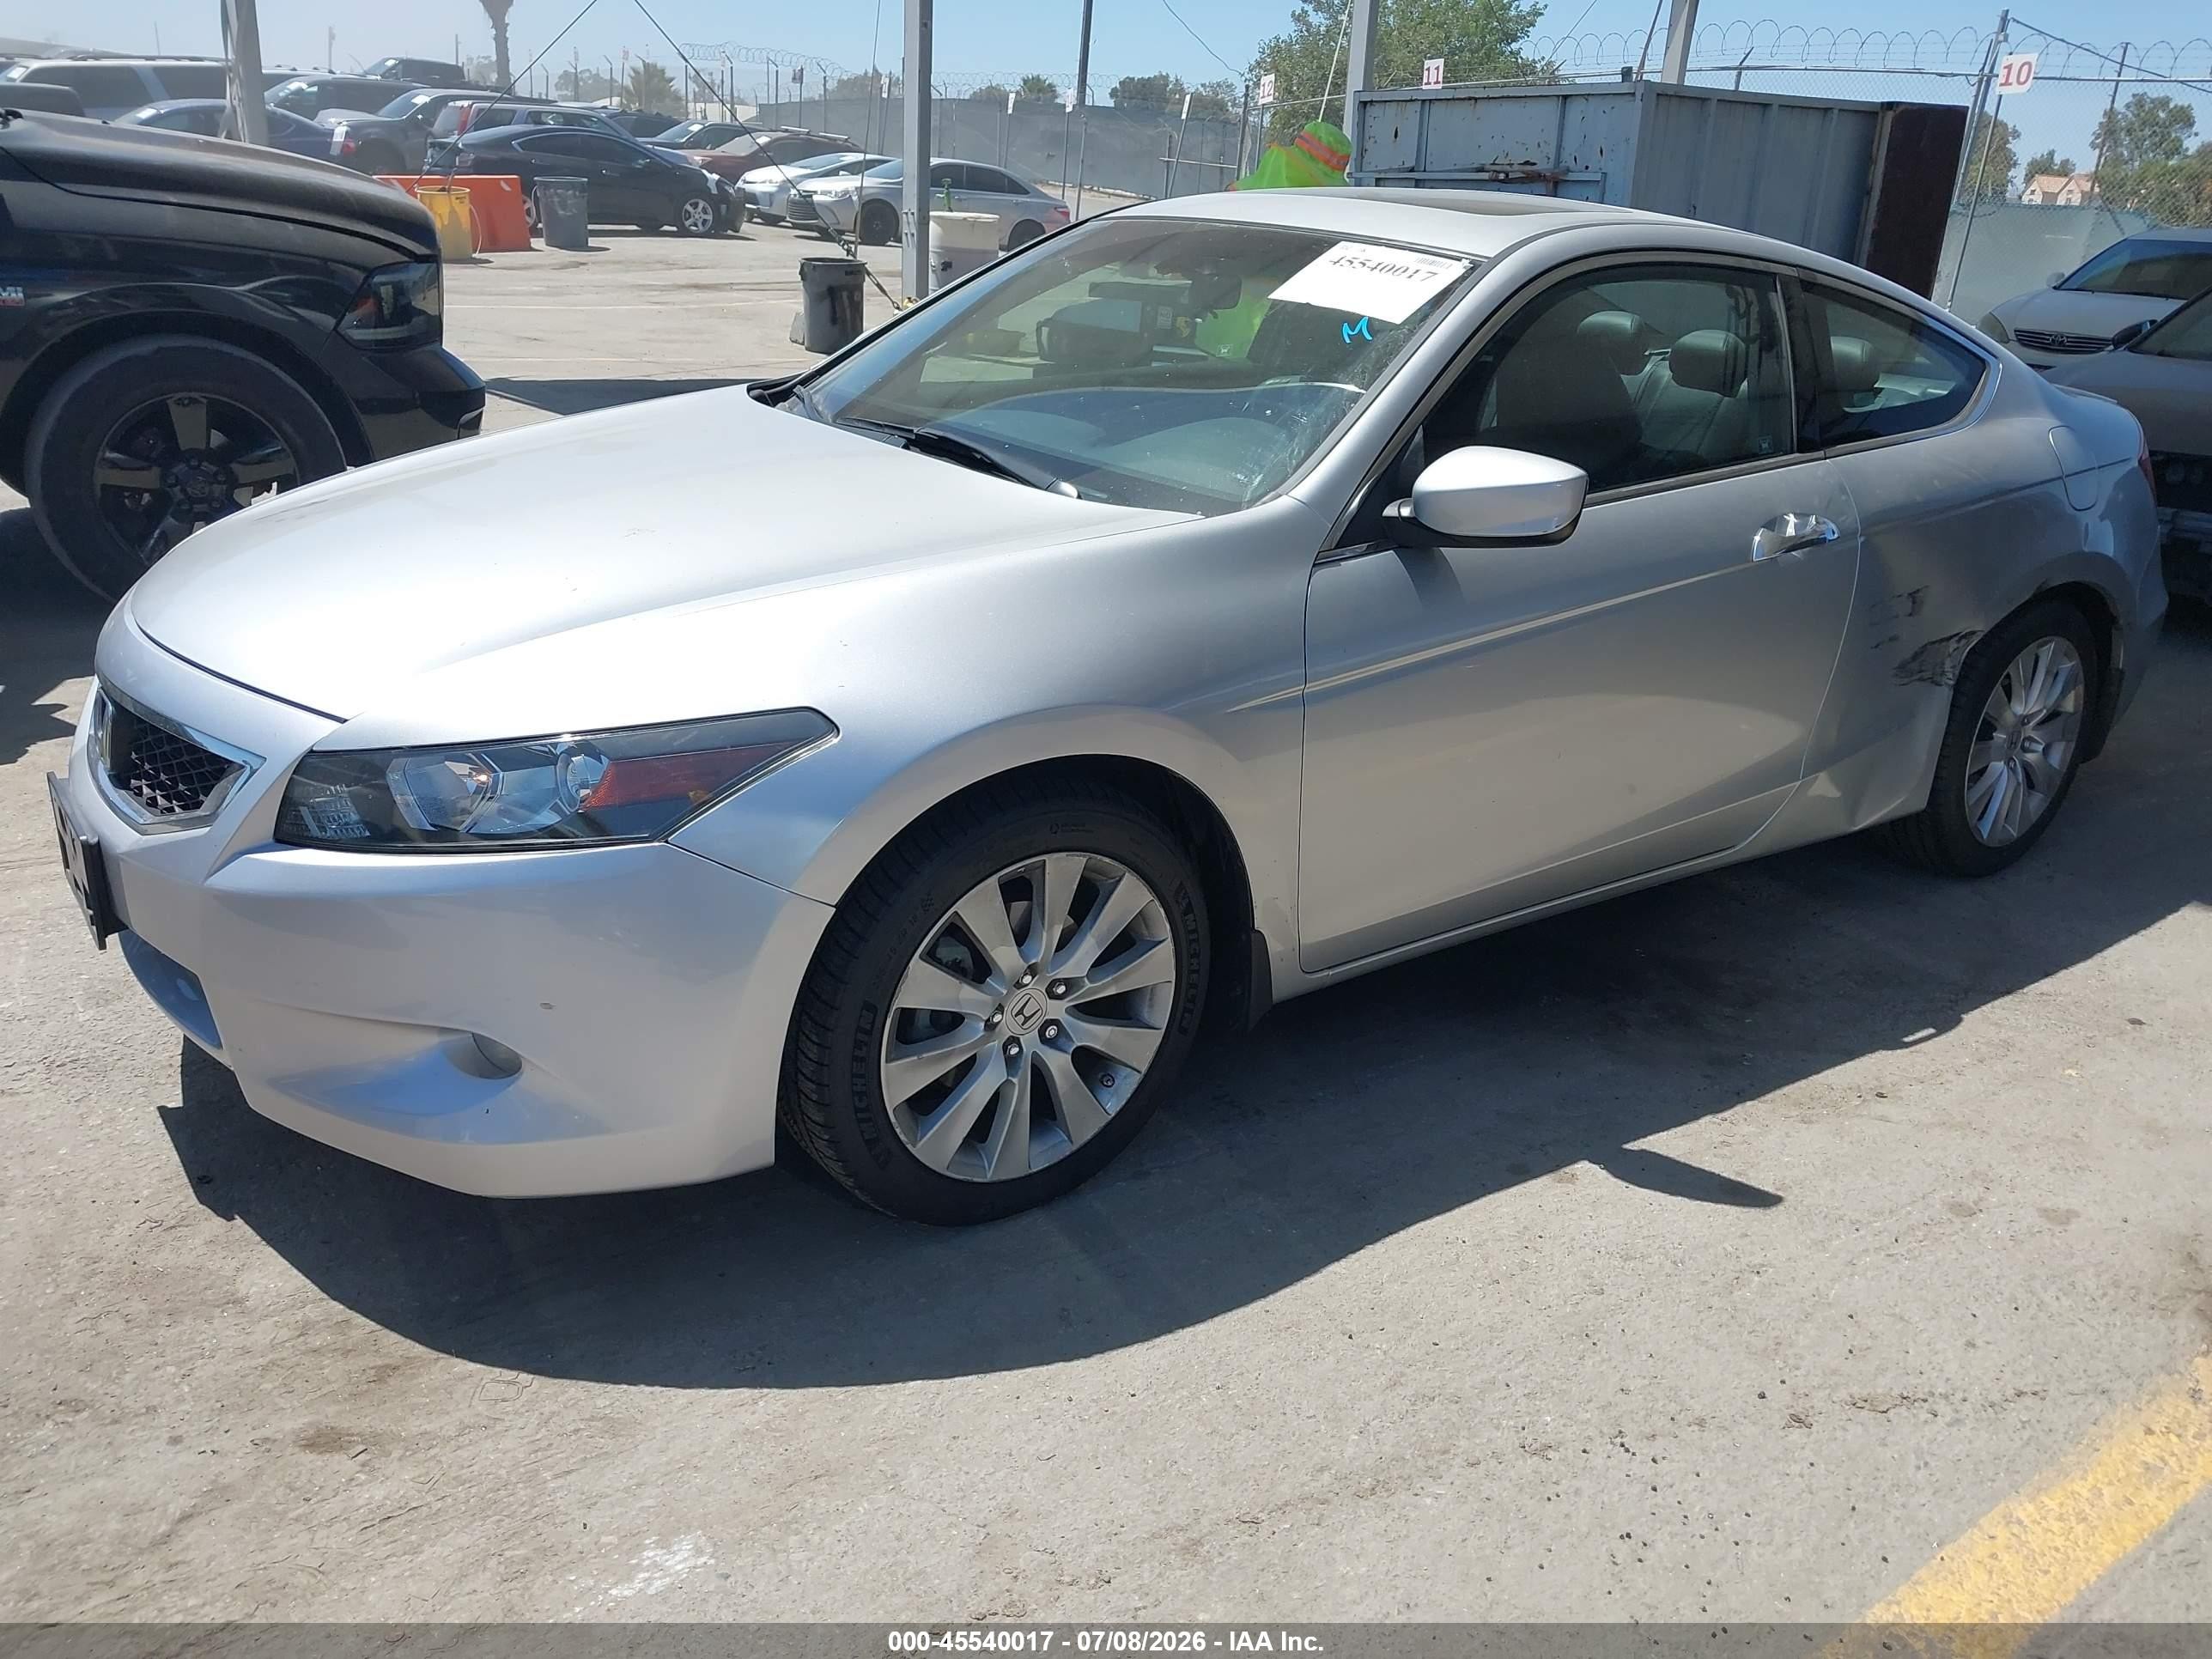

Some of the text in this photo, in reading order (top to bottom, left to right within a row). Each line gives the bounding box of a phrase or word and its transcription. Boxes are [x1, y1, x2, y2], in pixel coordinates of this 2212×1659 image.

[1424, 65, 1442, 85] 11
[1999, 61, 2033, 87] 10
[1261, 81, 1273, 99] 12
[1329, 256, 1438, 282] 45540017
[1342, 316, 1373, 343] M
[853, 1009, 878, 1141] MICHELIN
